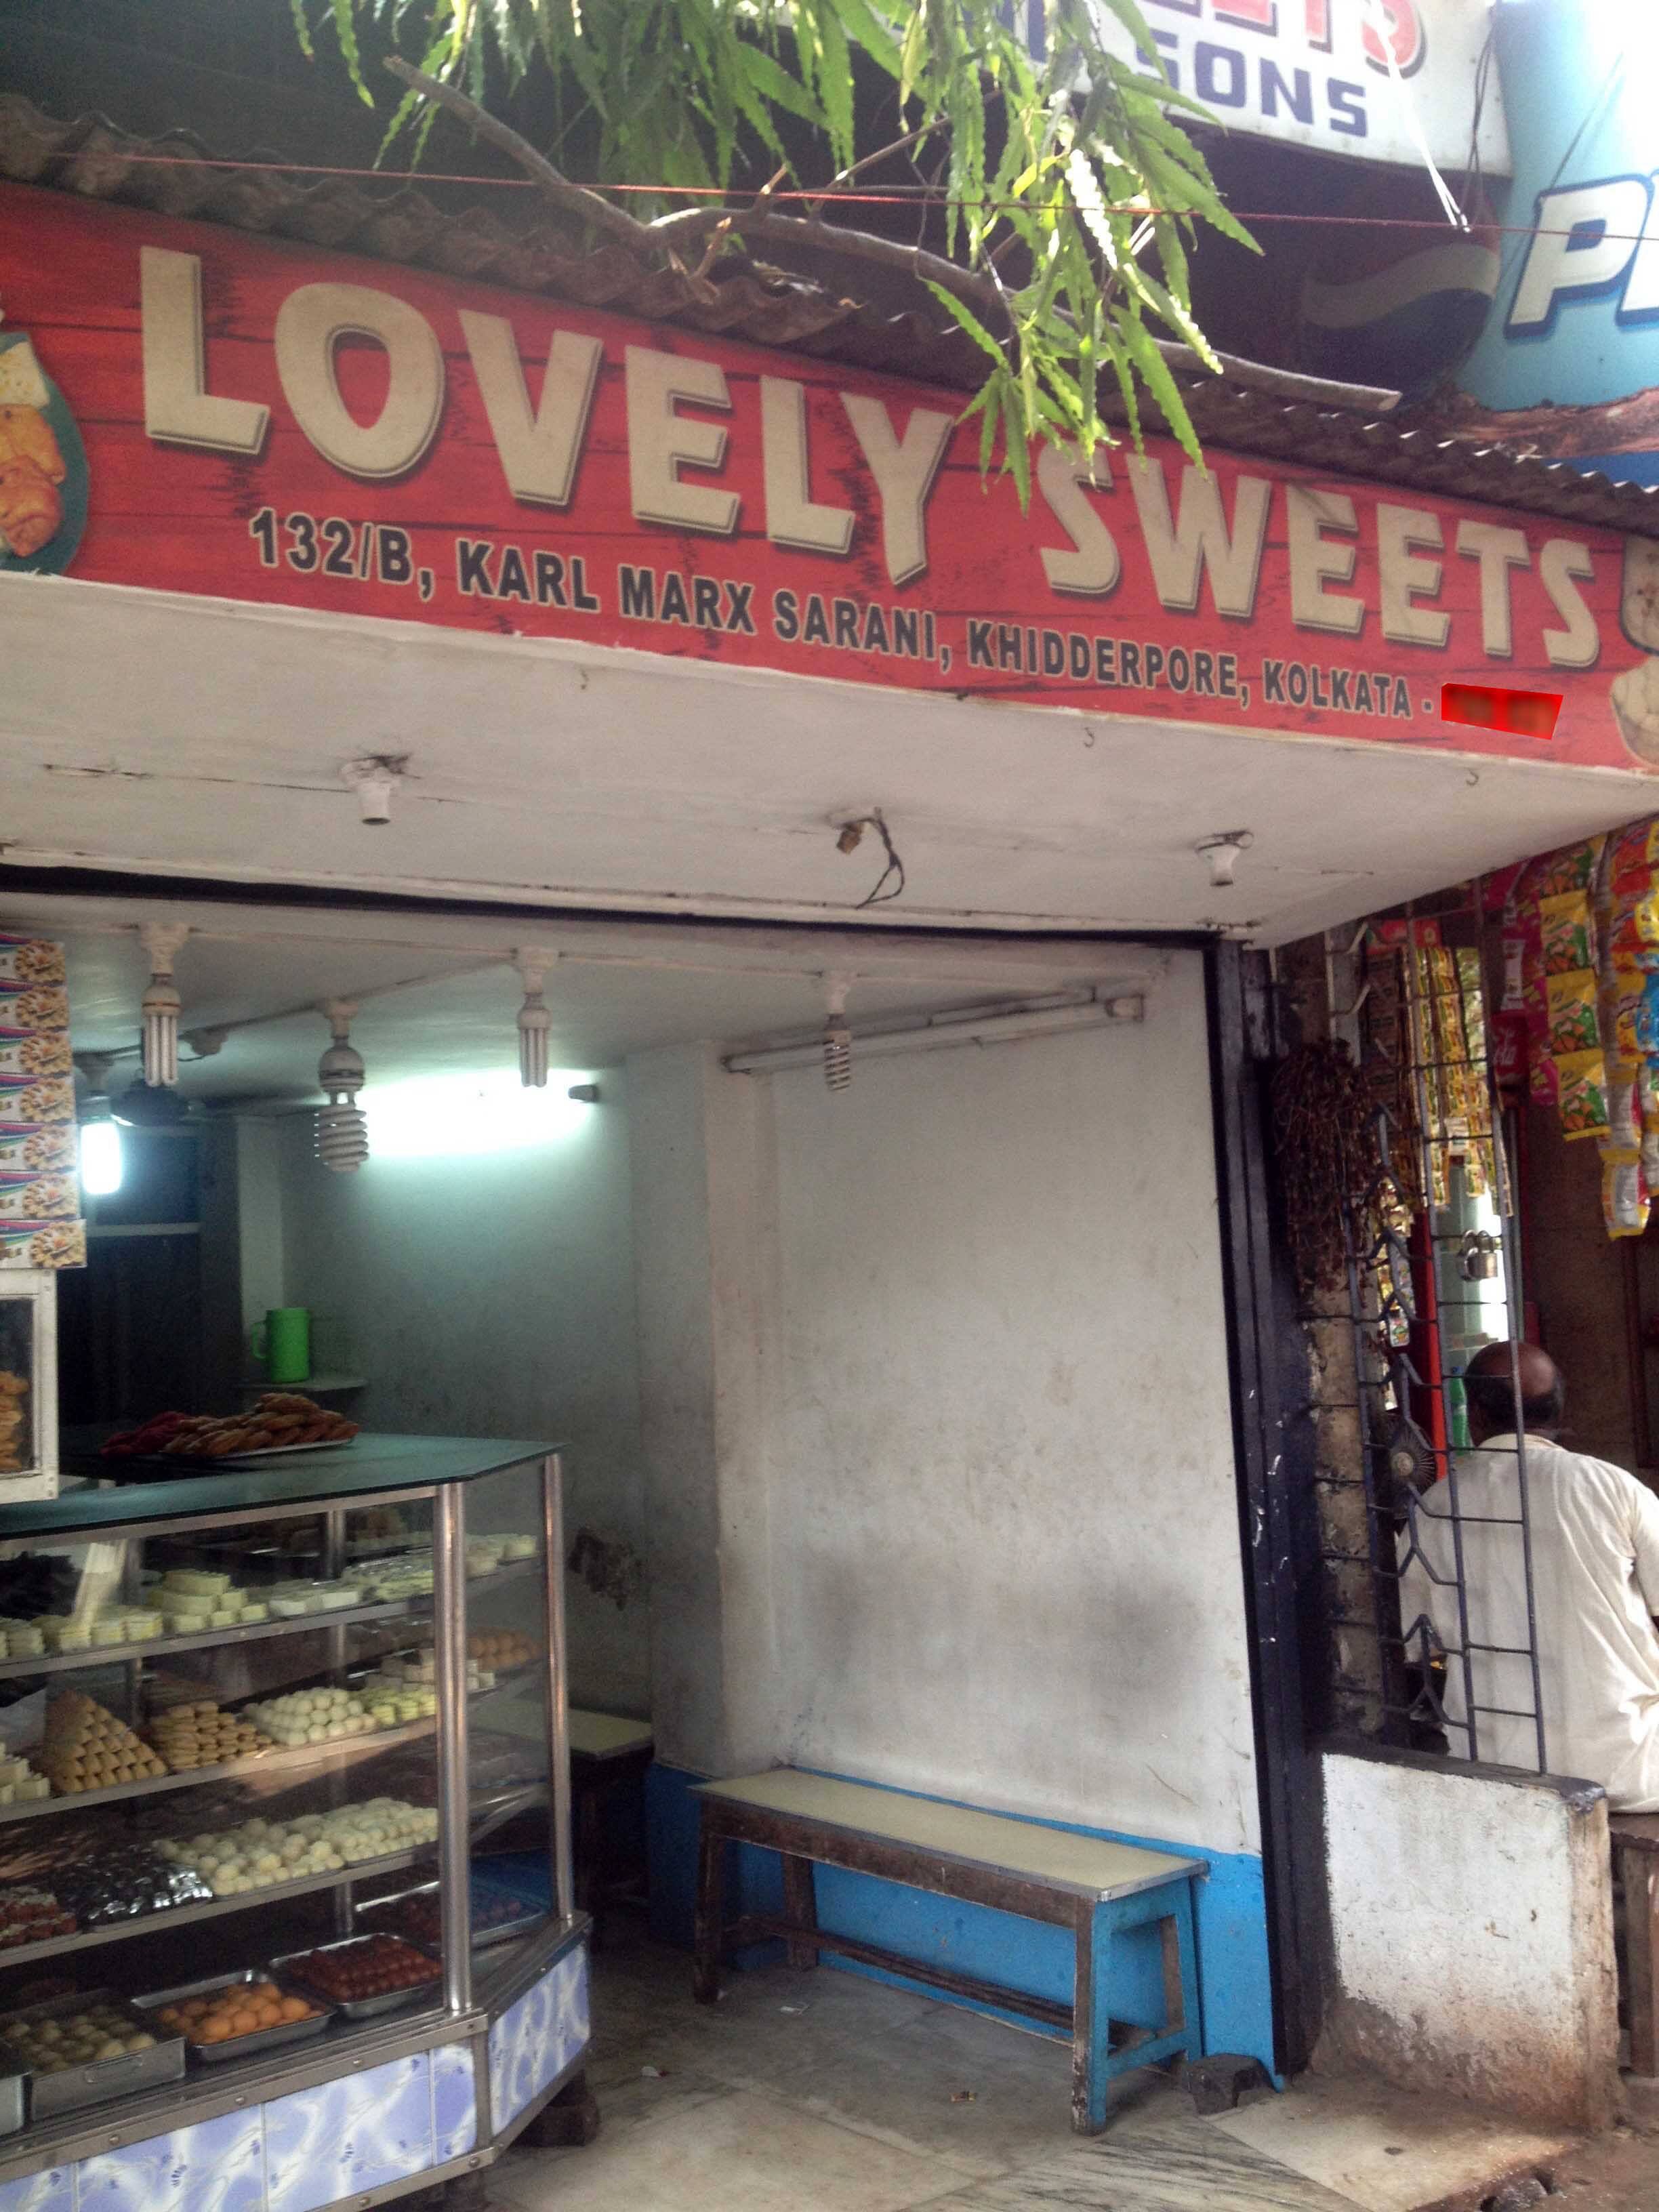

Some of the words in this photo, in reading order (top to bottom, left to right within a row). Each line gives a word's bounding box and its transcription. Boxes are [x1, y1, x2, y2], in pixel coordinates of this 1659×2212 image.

[140, 245, 954, 586] LOVELY
[1037, 439, 1599, 668] SWEETS
[249, 508, 434, 602] 132/B,
[457, 538, 600, 613] KARL
[617, 563, 758, 635] MARX
[773, 588, 951, 673] SARANI,
[966, 619, 1250, 709] KHIDDERPORE,
[1263, 659, 1414, 719] KOLKATA
